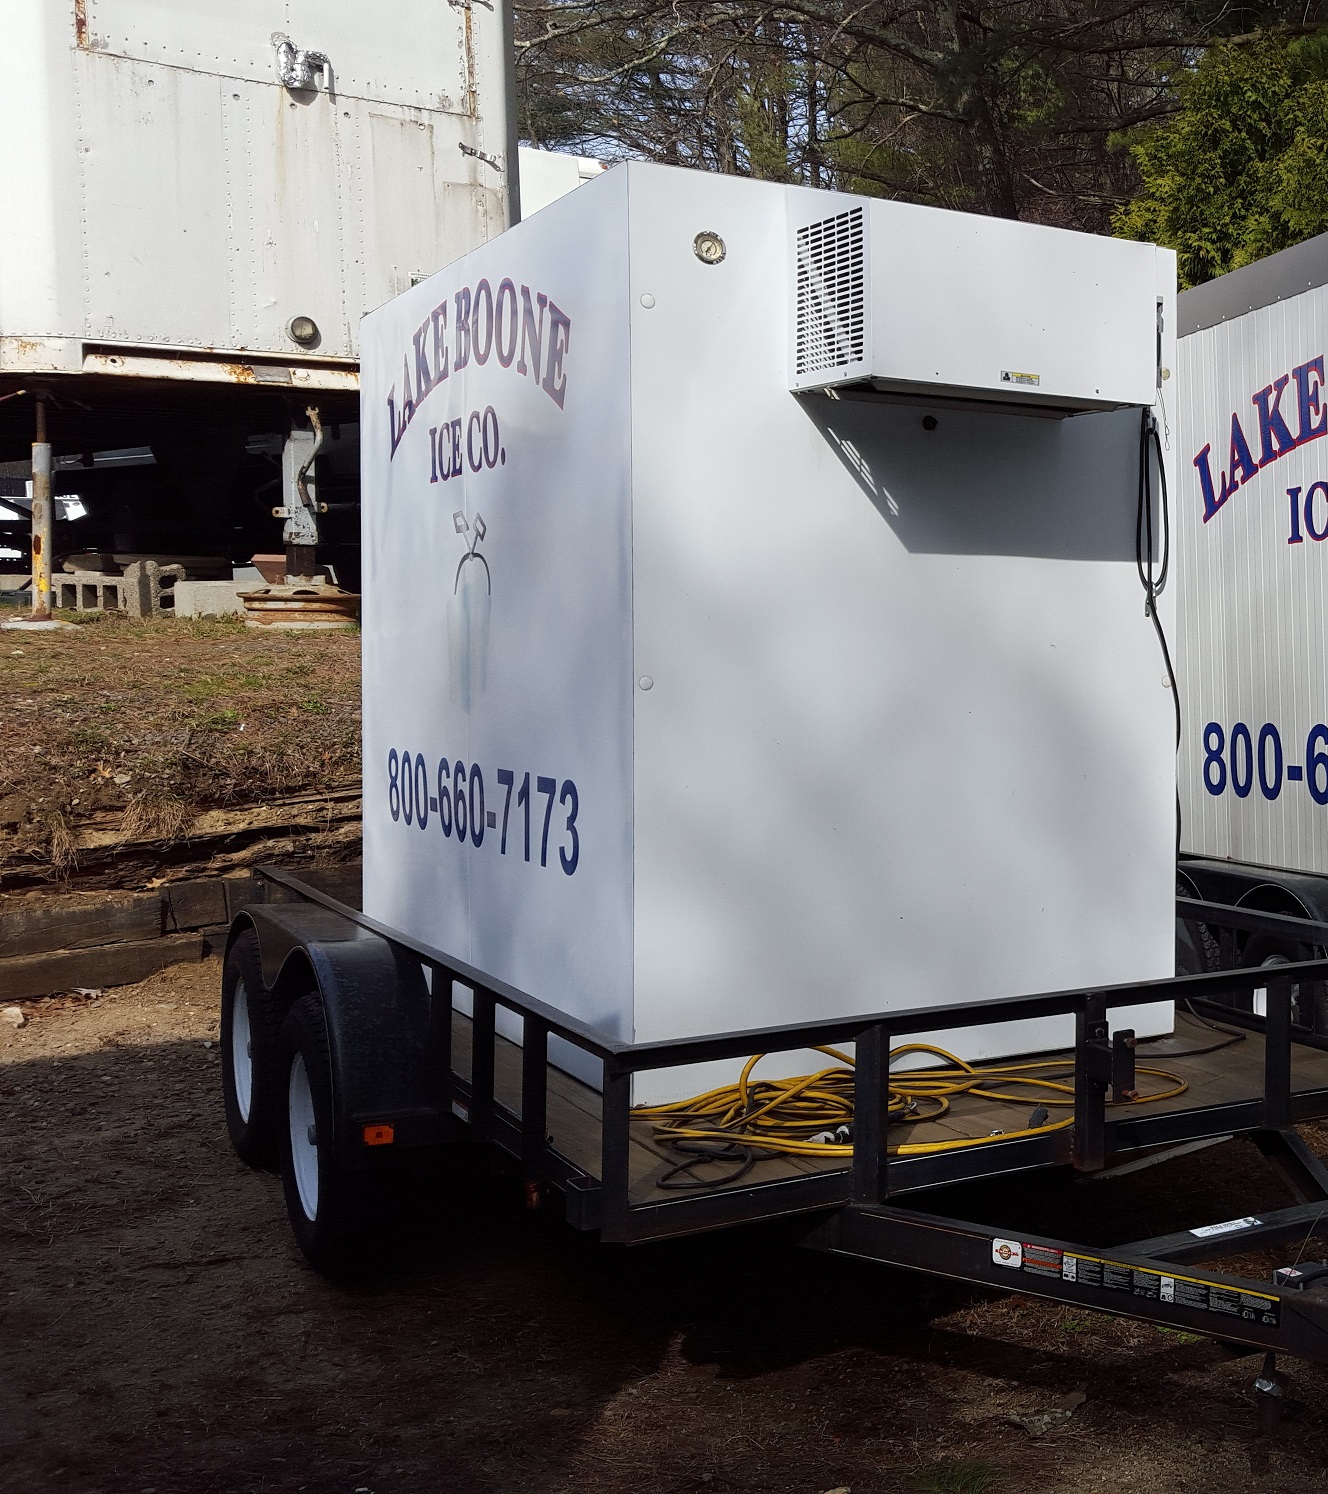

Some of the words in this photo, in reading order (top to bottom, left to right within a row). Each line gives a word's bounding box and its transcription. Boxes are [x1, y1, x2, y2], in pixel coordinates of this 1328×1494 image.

[387, 298, 448, 461] LAKE
[454, 277, 572, 410] BOONE
[1193, 354, 1328, 524] LAKE
[429, 417, 463, 484] ICE
[467, 405, 506, 474] CO.
[388, 747, 580, 876] 800-660-7173
